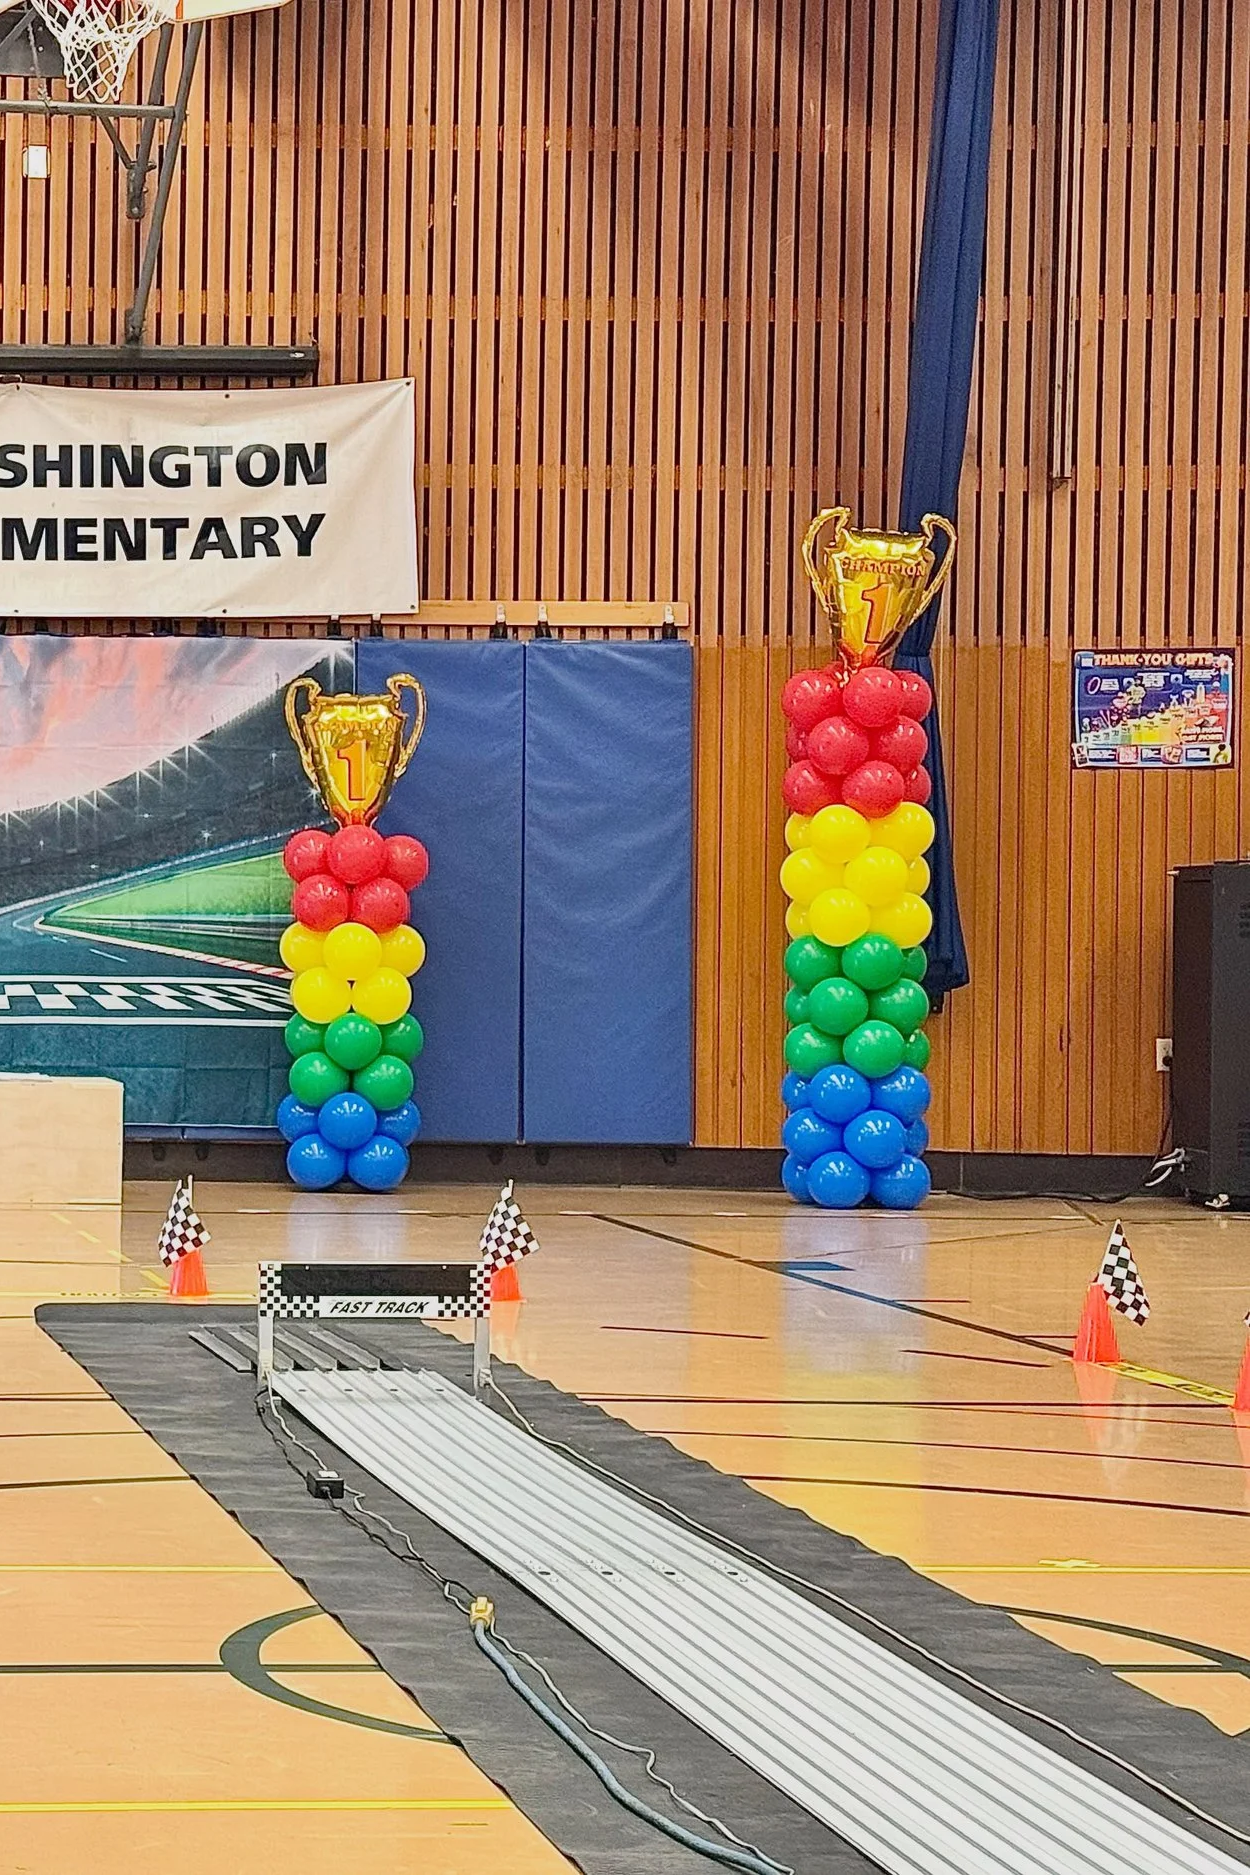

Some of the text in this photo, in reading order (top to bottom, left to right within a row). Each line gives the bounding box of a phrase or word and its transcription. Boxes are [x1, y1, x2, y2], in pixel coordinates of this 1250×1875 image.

[841, 557, 927, 576] CHAMPION
[861, 583, 892, 645] 1
[337, 739, 367, 801] 1
[329, 1301, 429, 1314] FAST TRACK
